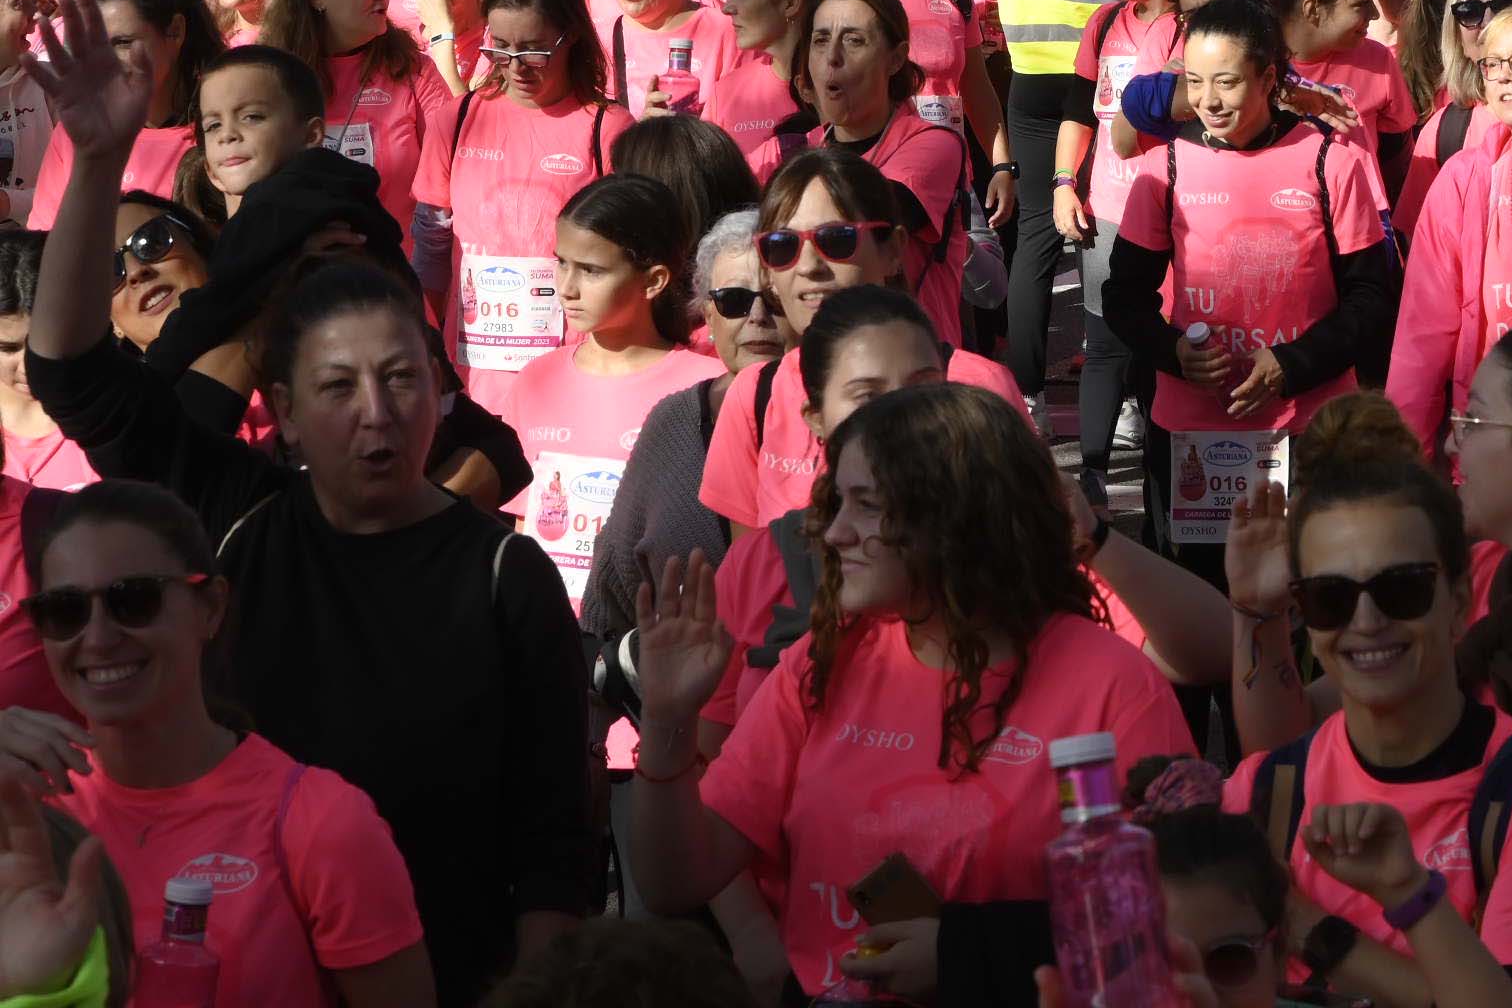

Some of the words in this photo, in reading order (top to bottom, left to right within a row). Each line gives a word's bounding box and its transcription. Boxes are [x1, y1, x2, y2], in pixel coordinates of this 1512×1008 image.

[734, 119, 776, 132] OYSHO
[458, 146, 505, 161] OYSHO
[543, 160, 581, 171] ASTURIANA
[1179, 193, 1229, 206] OYSHO
[478, 275, 522, 287] ASTURIANA
[530, 272, 554, 280] SUMA
[1185, 287, 1214, 314] TU
[480, 302, 519, 318] 016
[483, 321, 514, 333] 27983
[1207, 449, 1248, 460] ASTURIANA
[1209, 476, 1247, 491] 016
[576, 540, 595, 552] 25
[578, 557, 590, 566] DE
